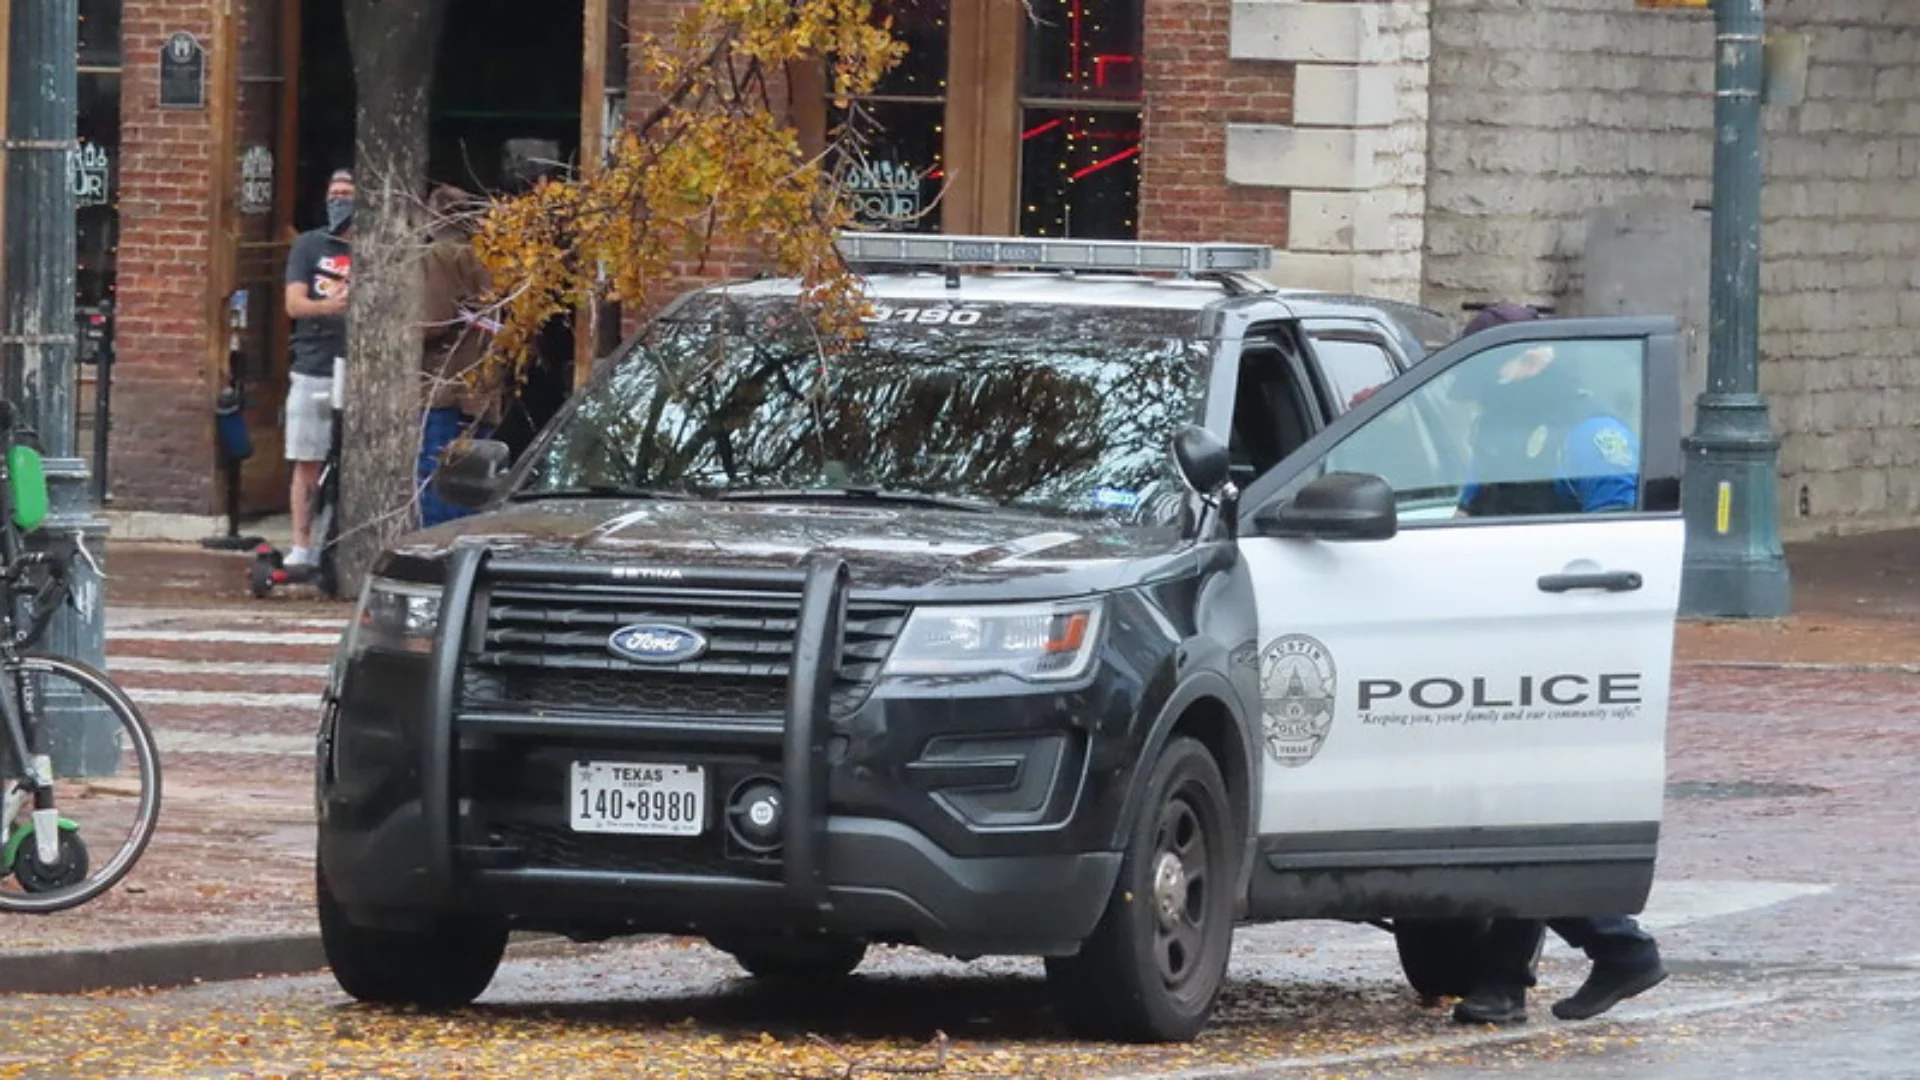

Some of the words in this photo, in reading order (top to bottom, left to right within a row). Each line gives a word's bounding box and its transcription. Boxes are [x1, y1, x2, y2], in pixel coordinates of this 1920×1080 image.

[626, 632, 682, 652] Ford
[1357, 673, 1642, 711] POLICE
[1462, 709, 1498, 725] family
[1502, 708, 1524, 721] and
[1526, 711, 1545, 720] our
[1547, 708, 1607, 721] community
[1271, 721, 1318, 737] POLICE
[612, 766, 663, 782] TEXAS
